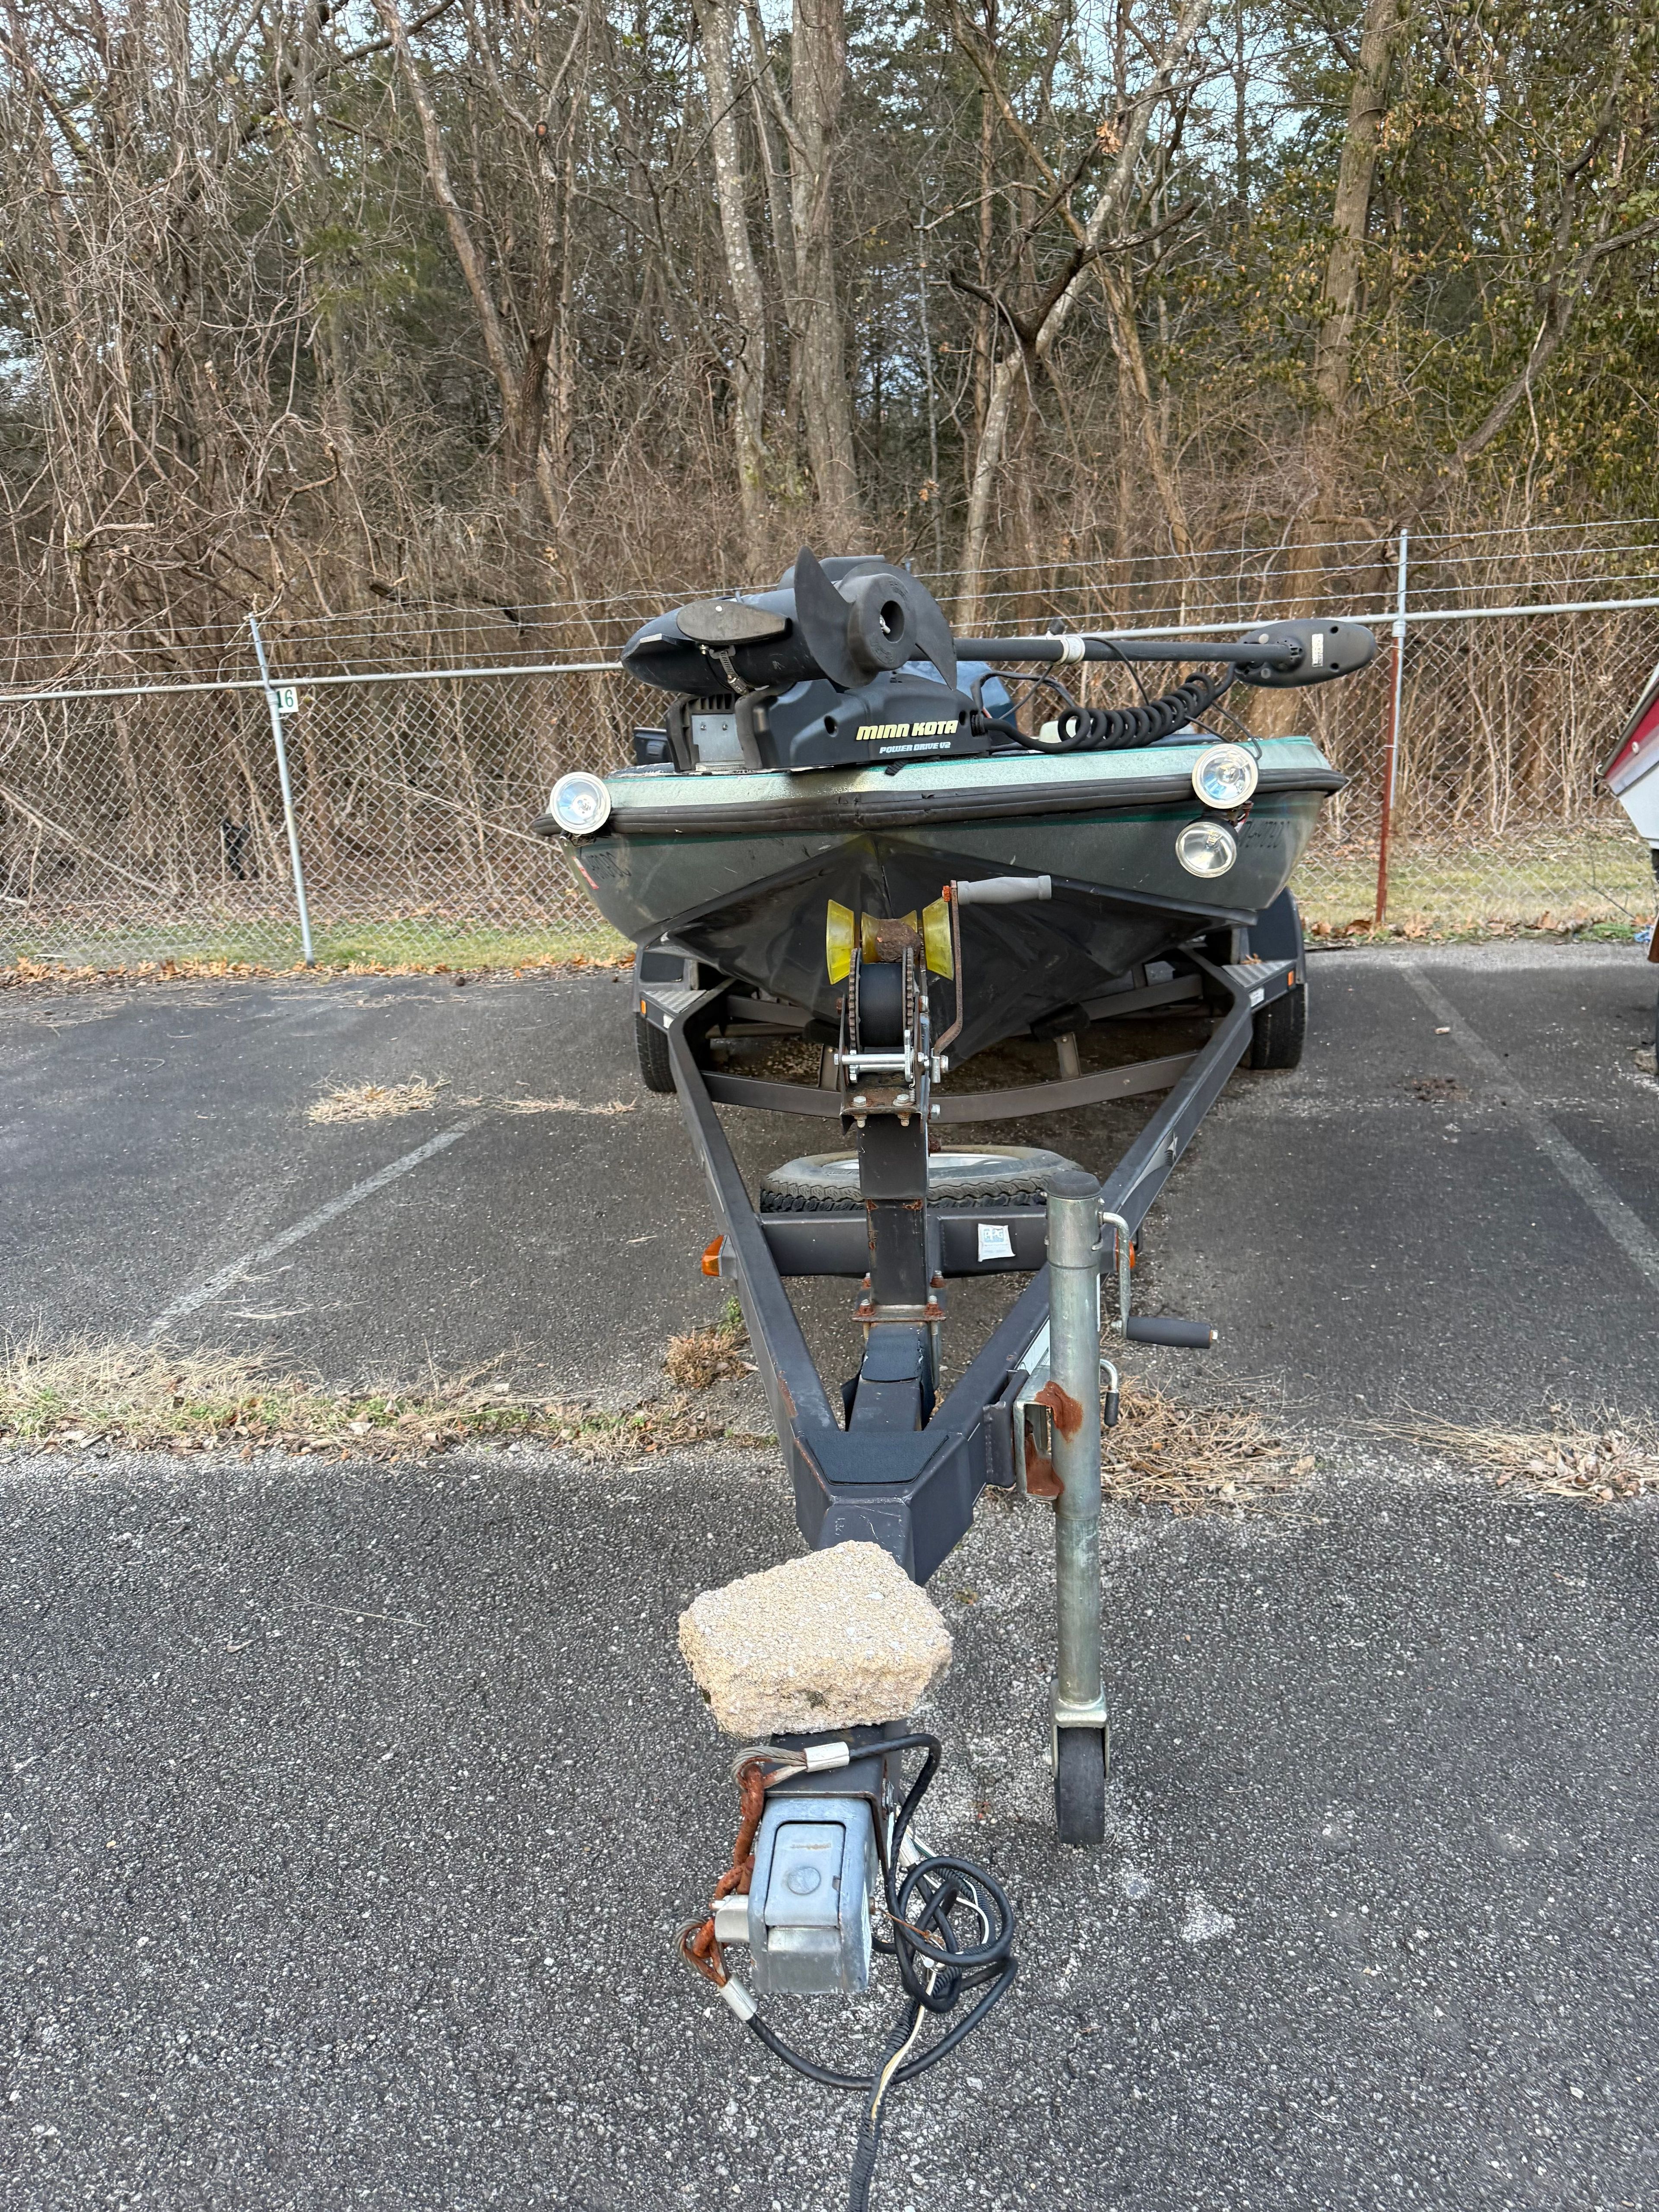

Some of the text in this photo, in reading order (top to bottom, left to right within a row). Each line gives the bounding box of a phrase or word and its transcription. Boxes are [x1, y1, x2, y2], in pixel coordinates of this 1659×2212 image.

[856, 720, 959, 741] MINN KOTA
[879, 744, 913, 754] POWER
[913, 742, 939, 751] DRIVE
